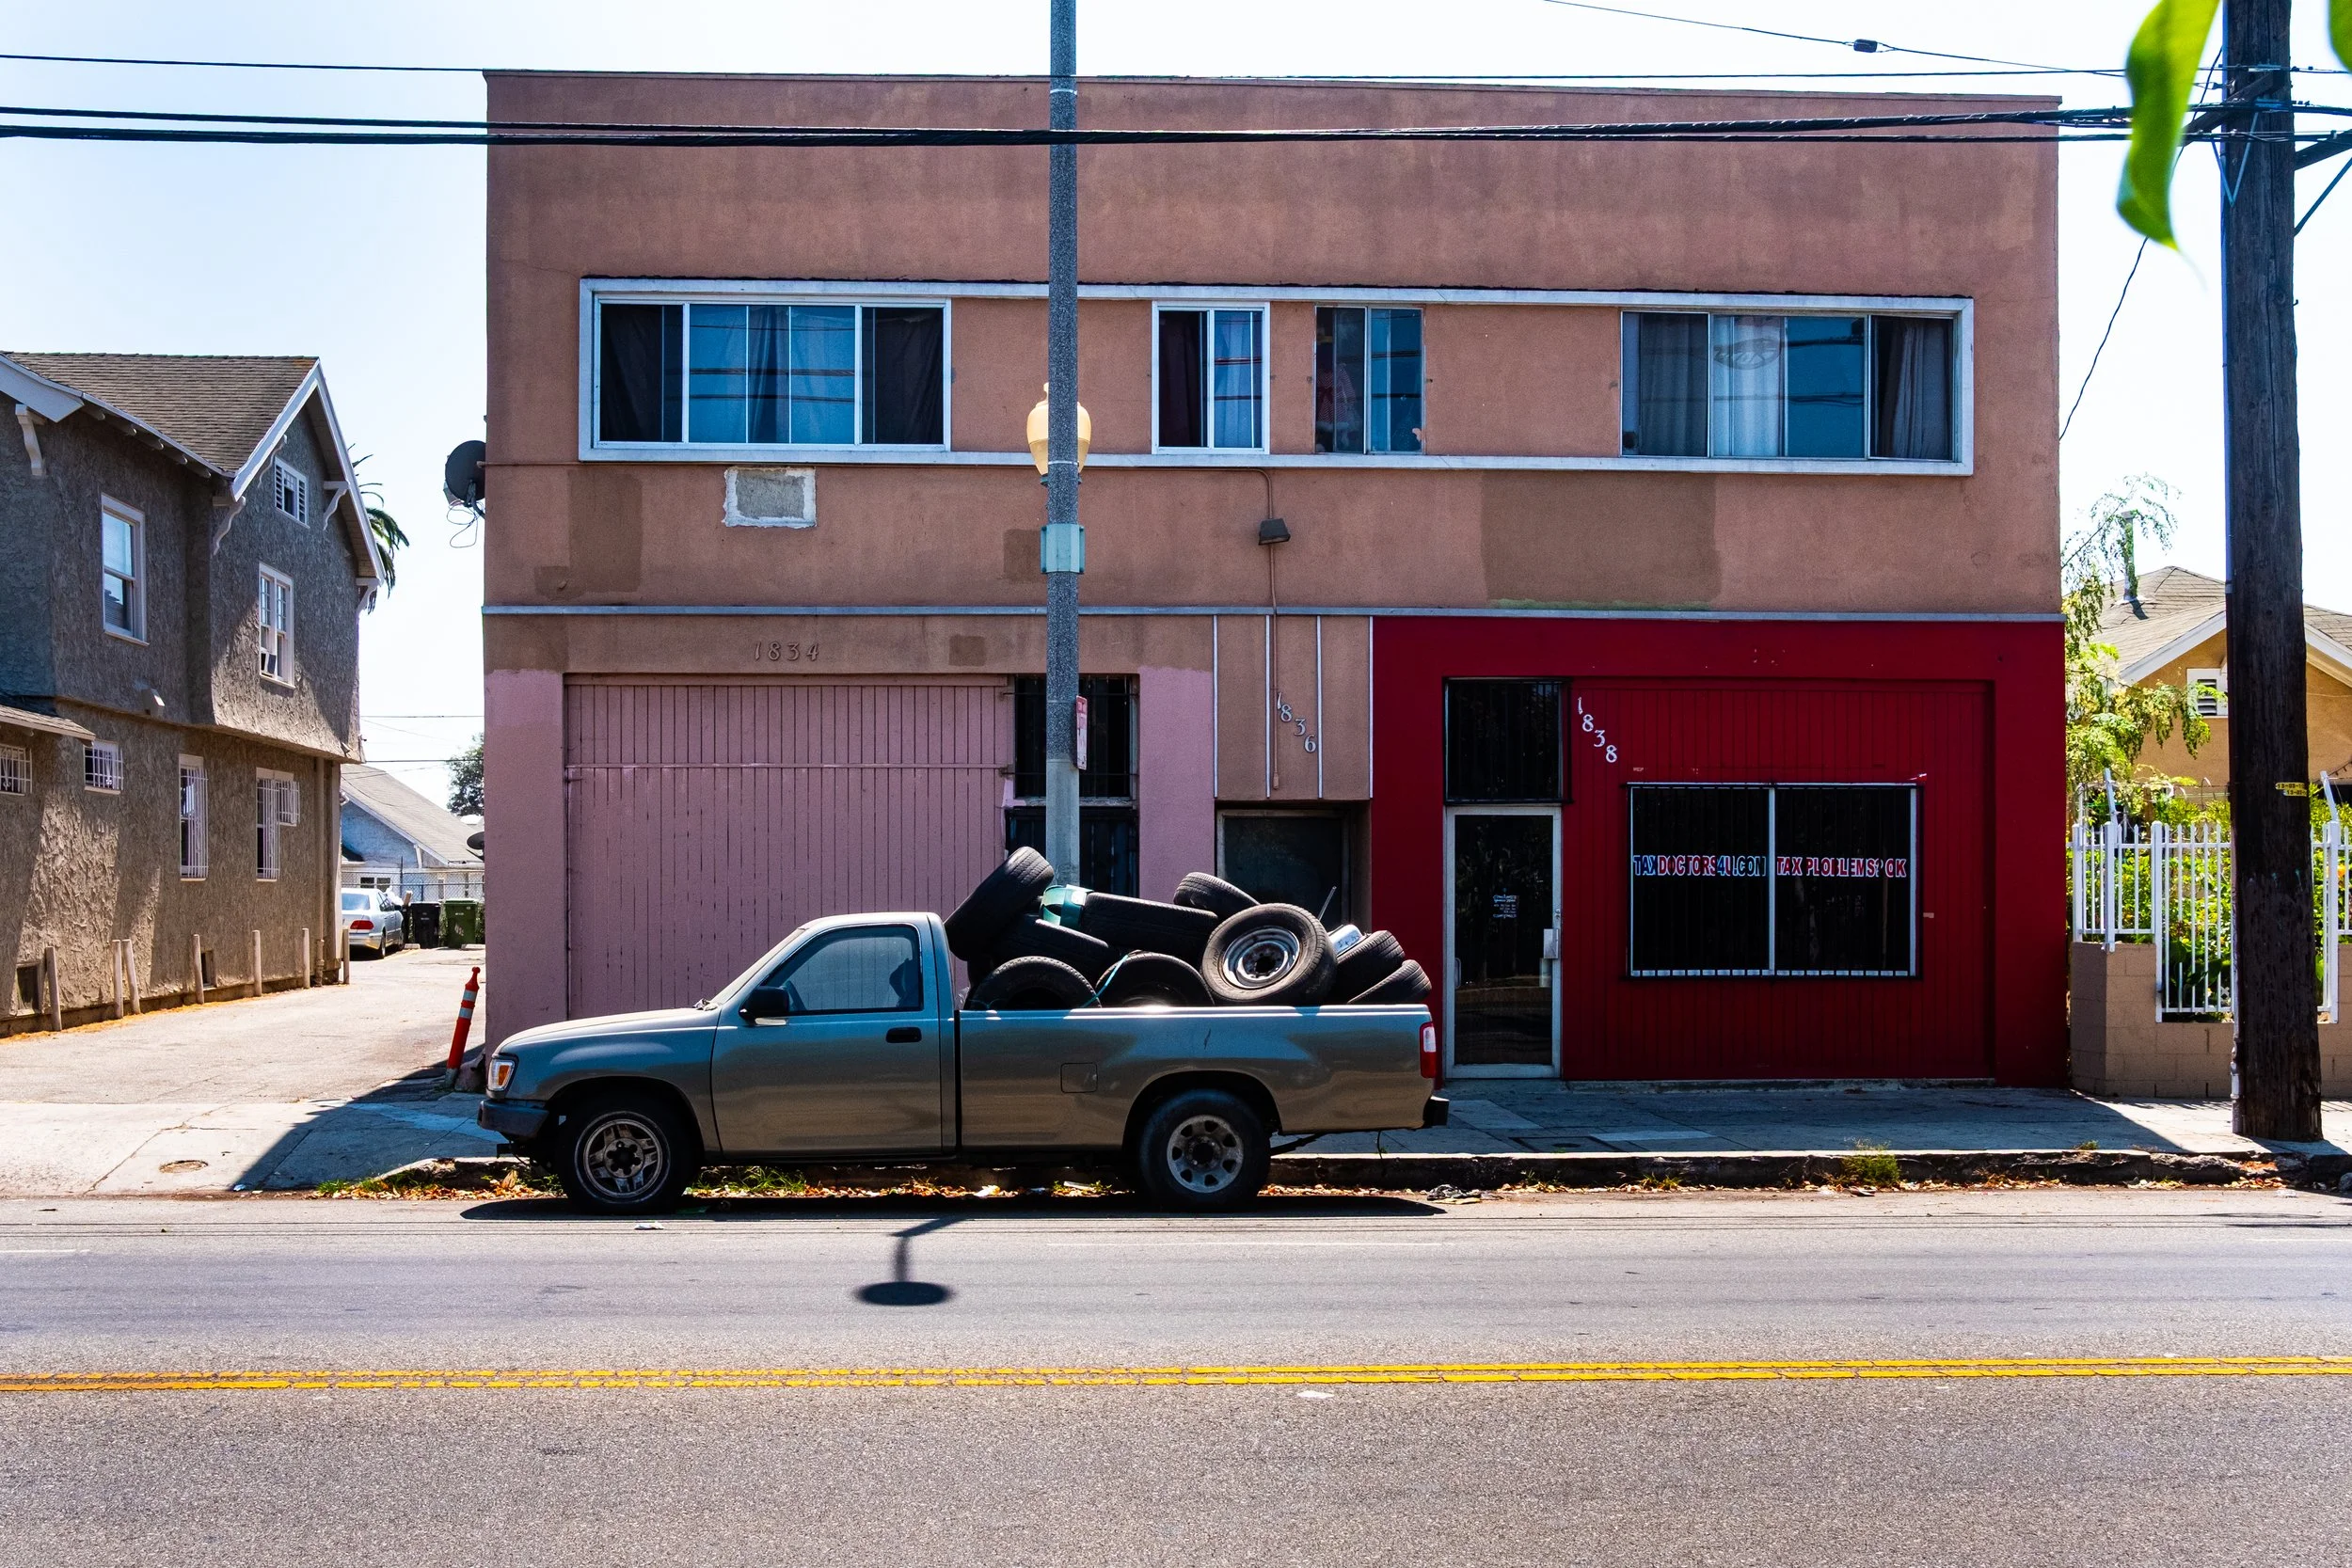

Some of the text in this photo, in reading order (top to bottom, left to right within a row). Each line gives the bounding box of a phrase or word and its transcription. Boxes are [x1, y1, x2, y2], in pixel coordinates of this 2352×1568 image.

[755, 641, 819, 661] 1834
[1277, 691, 1317, 752] 1836
[1577, 696, 1618, 763] 1838
[1776, 856, 1803, 877] TAX
